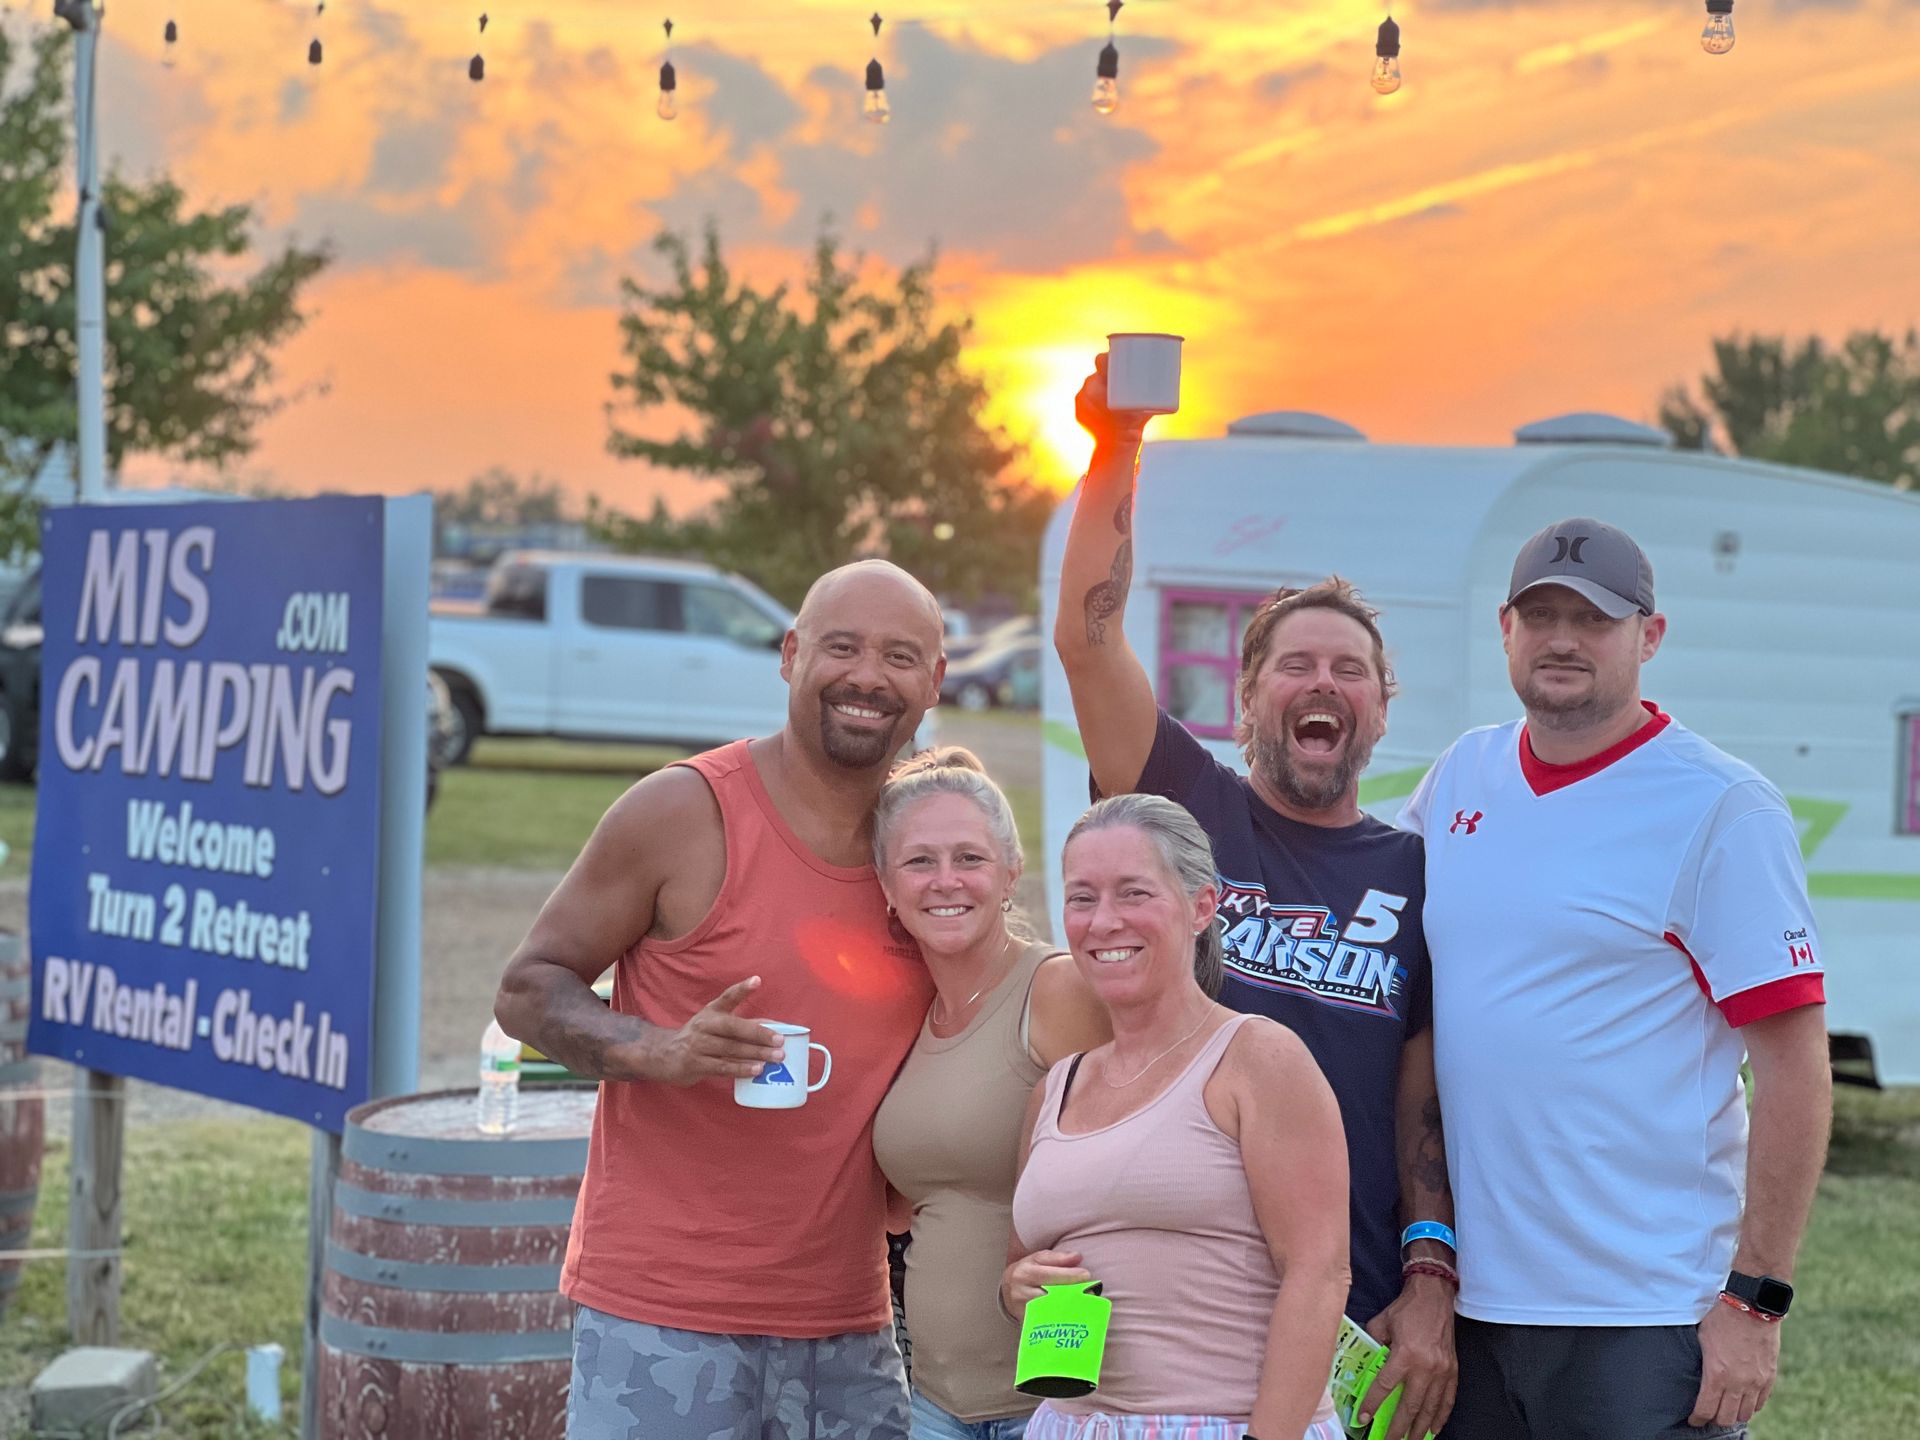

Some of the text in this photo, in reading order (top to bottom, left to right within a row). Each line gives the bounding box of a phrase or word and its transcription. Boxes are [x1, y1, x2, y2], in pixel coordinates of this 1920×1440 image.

[75, 525, 215, 647] MIS
[277, 592, 349, 652] .COM
[55, 655, 354, 795] CAMPING
[127, 798, 276, 879] Welcome
[88, 873, 311, 971] Turn 2 Retreat
[1223, 892, 1317, 938] KYE
[1343, 888, 1408, 944] 5
[1221, 916, 1398, 997] ARSON
[1223, 952, 1274, 974] ENDRICK
[43, 956, 349, 1090] RV Rental Check In
[1029, 1329, 1089, 1342] CAMPING
[1056, 1338, 1083, 1349] MIS
